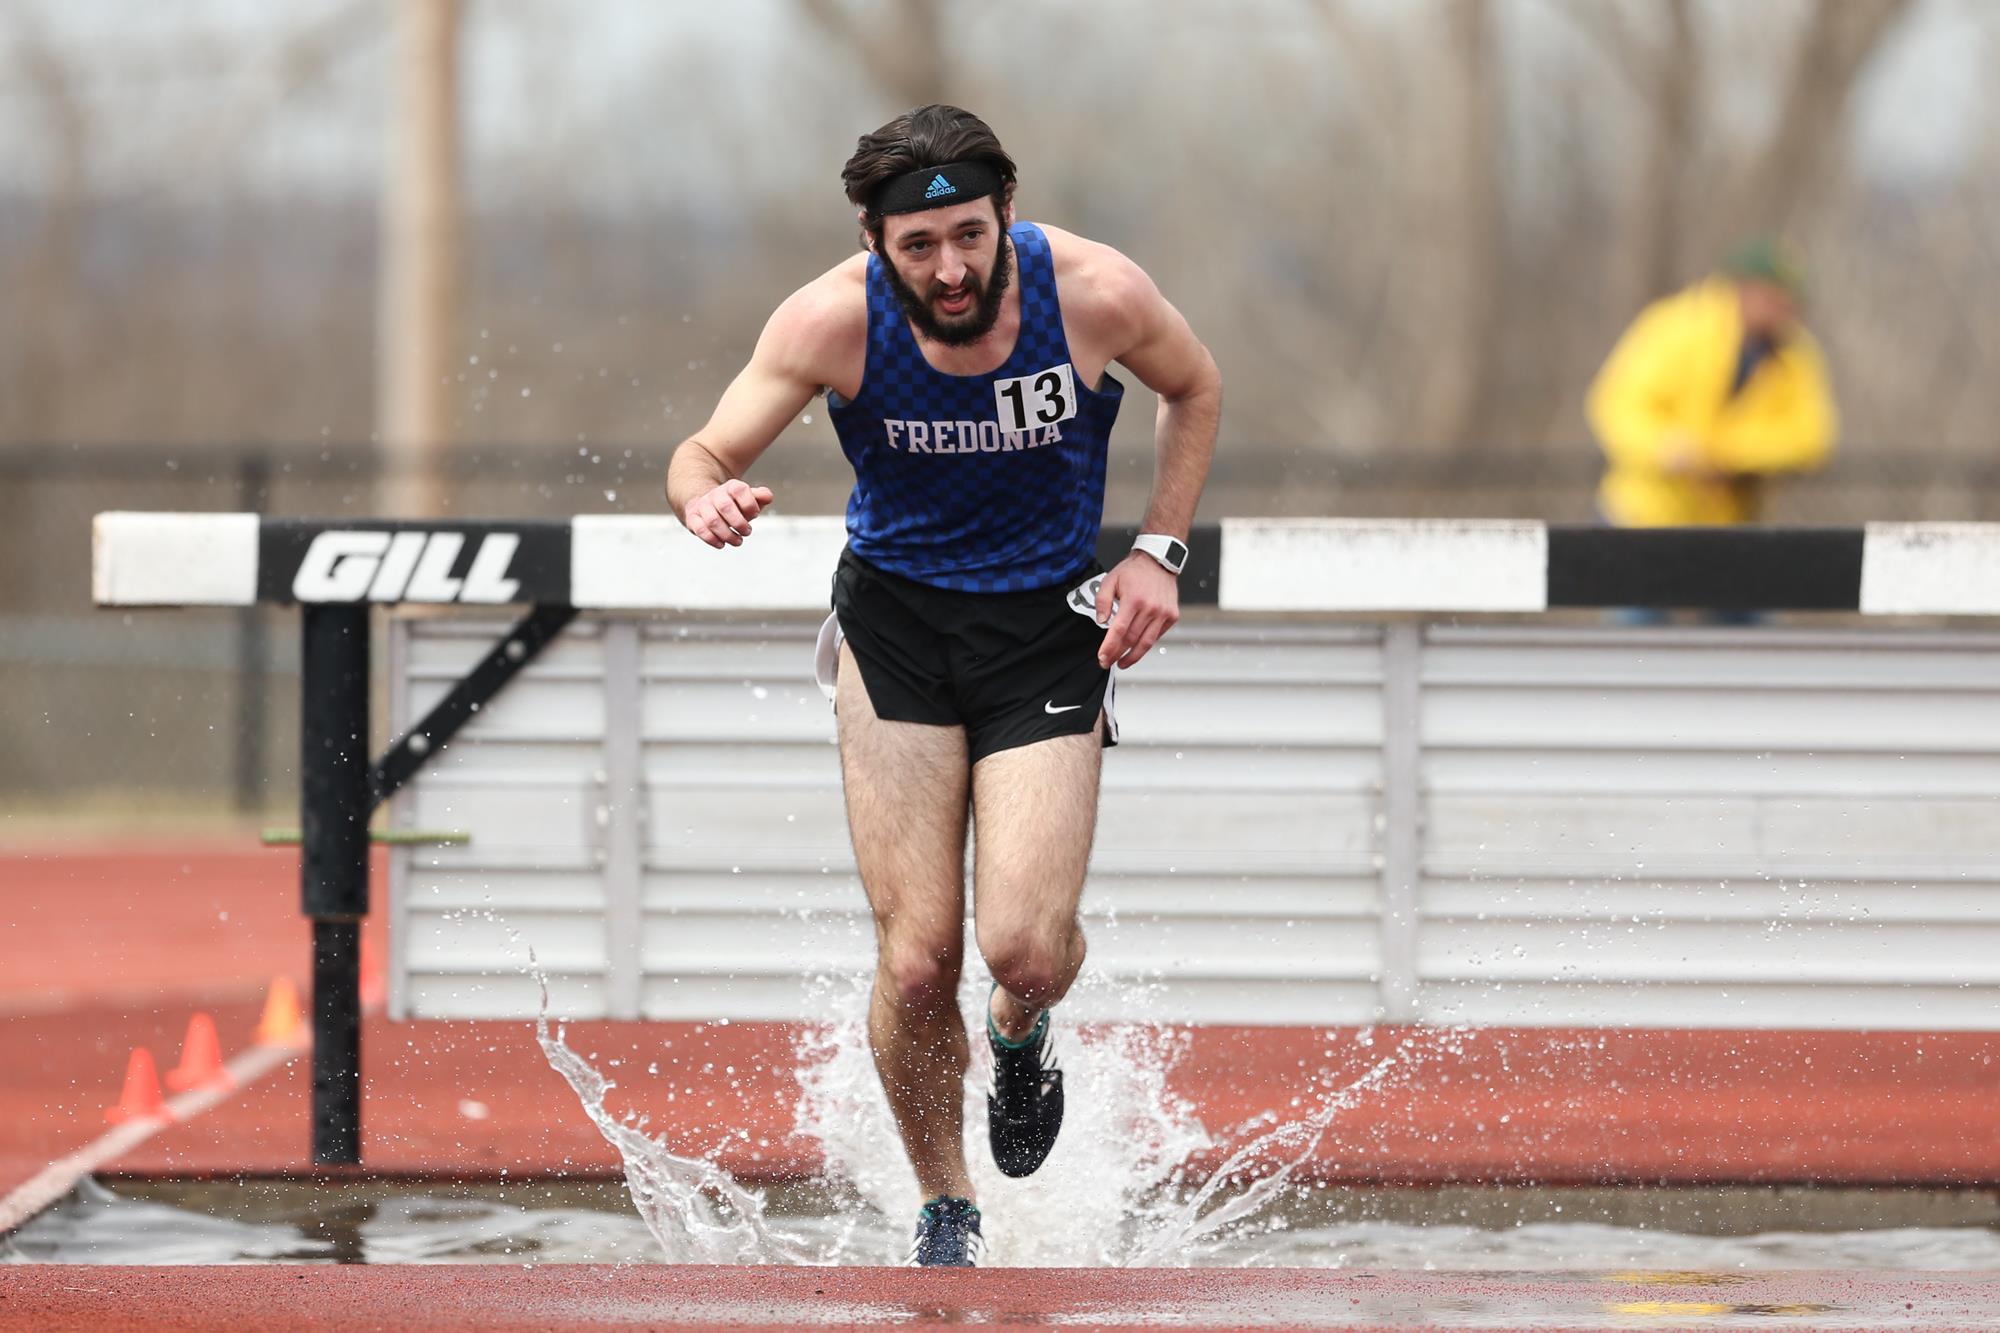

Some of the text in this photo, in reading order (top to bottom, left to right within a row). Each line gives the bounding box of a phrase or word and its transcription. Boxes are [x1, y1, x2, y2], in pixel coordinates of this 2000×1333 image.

[925, 186, 957, 199] adidas
[1001, 372, 1066, 429] 13
[884, 418, 1063, 454] FREDONIA
[292, 530, 520, 604] GILL
